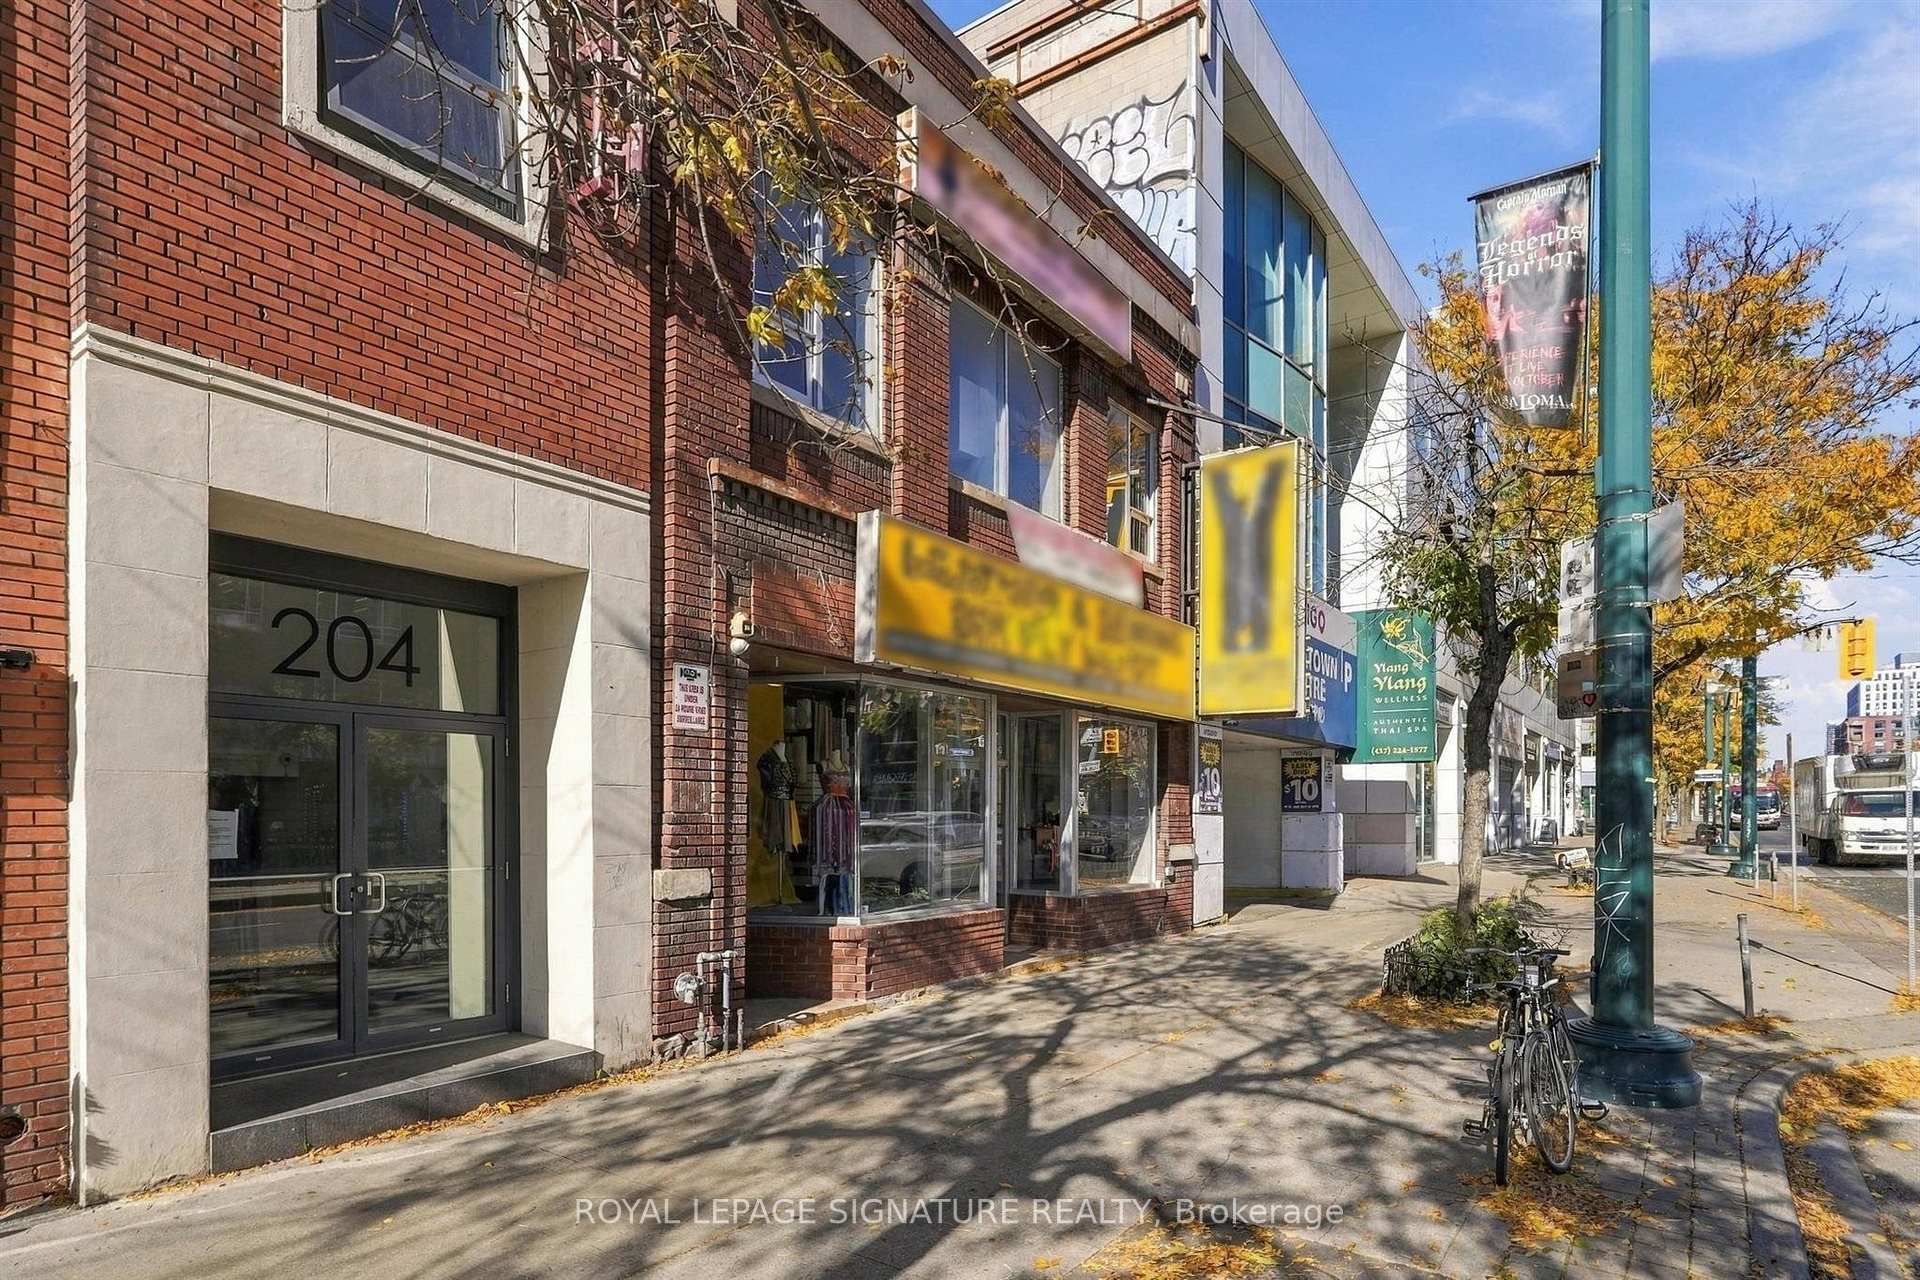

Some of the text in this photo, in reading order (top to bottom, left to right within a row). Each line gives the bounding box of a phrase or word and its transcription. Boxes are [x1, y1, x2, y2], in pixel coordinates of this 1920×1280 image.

[1478, 224, 1585, 265] Legends
[1480, 250, 1578, 287] Horror
[271, 607, 421, 688] 204
[1373, 663, 1409, 675] Ylang
[1372, 676, 1427, 694] Ylang
[1375, 695, 1428, 704] WELLNESS
[1373, 717, 1428, 726] AUTHENTIC
[1373, 726, 1428, 735] THAI SPA
[1283, 778, 1319, 801] $10
